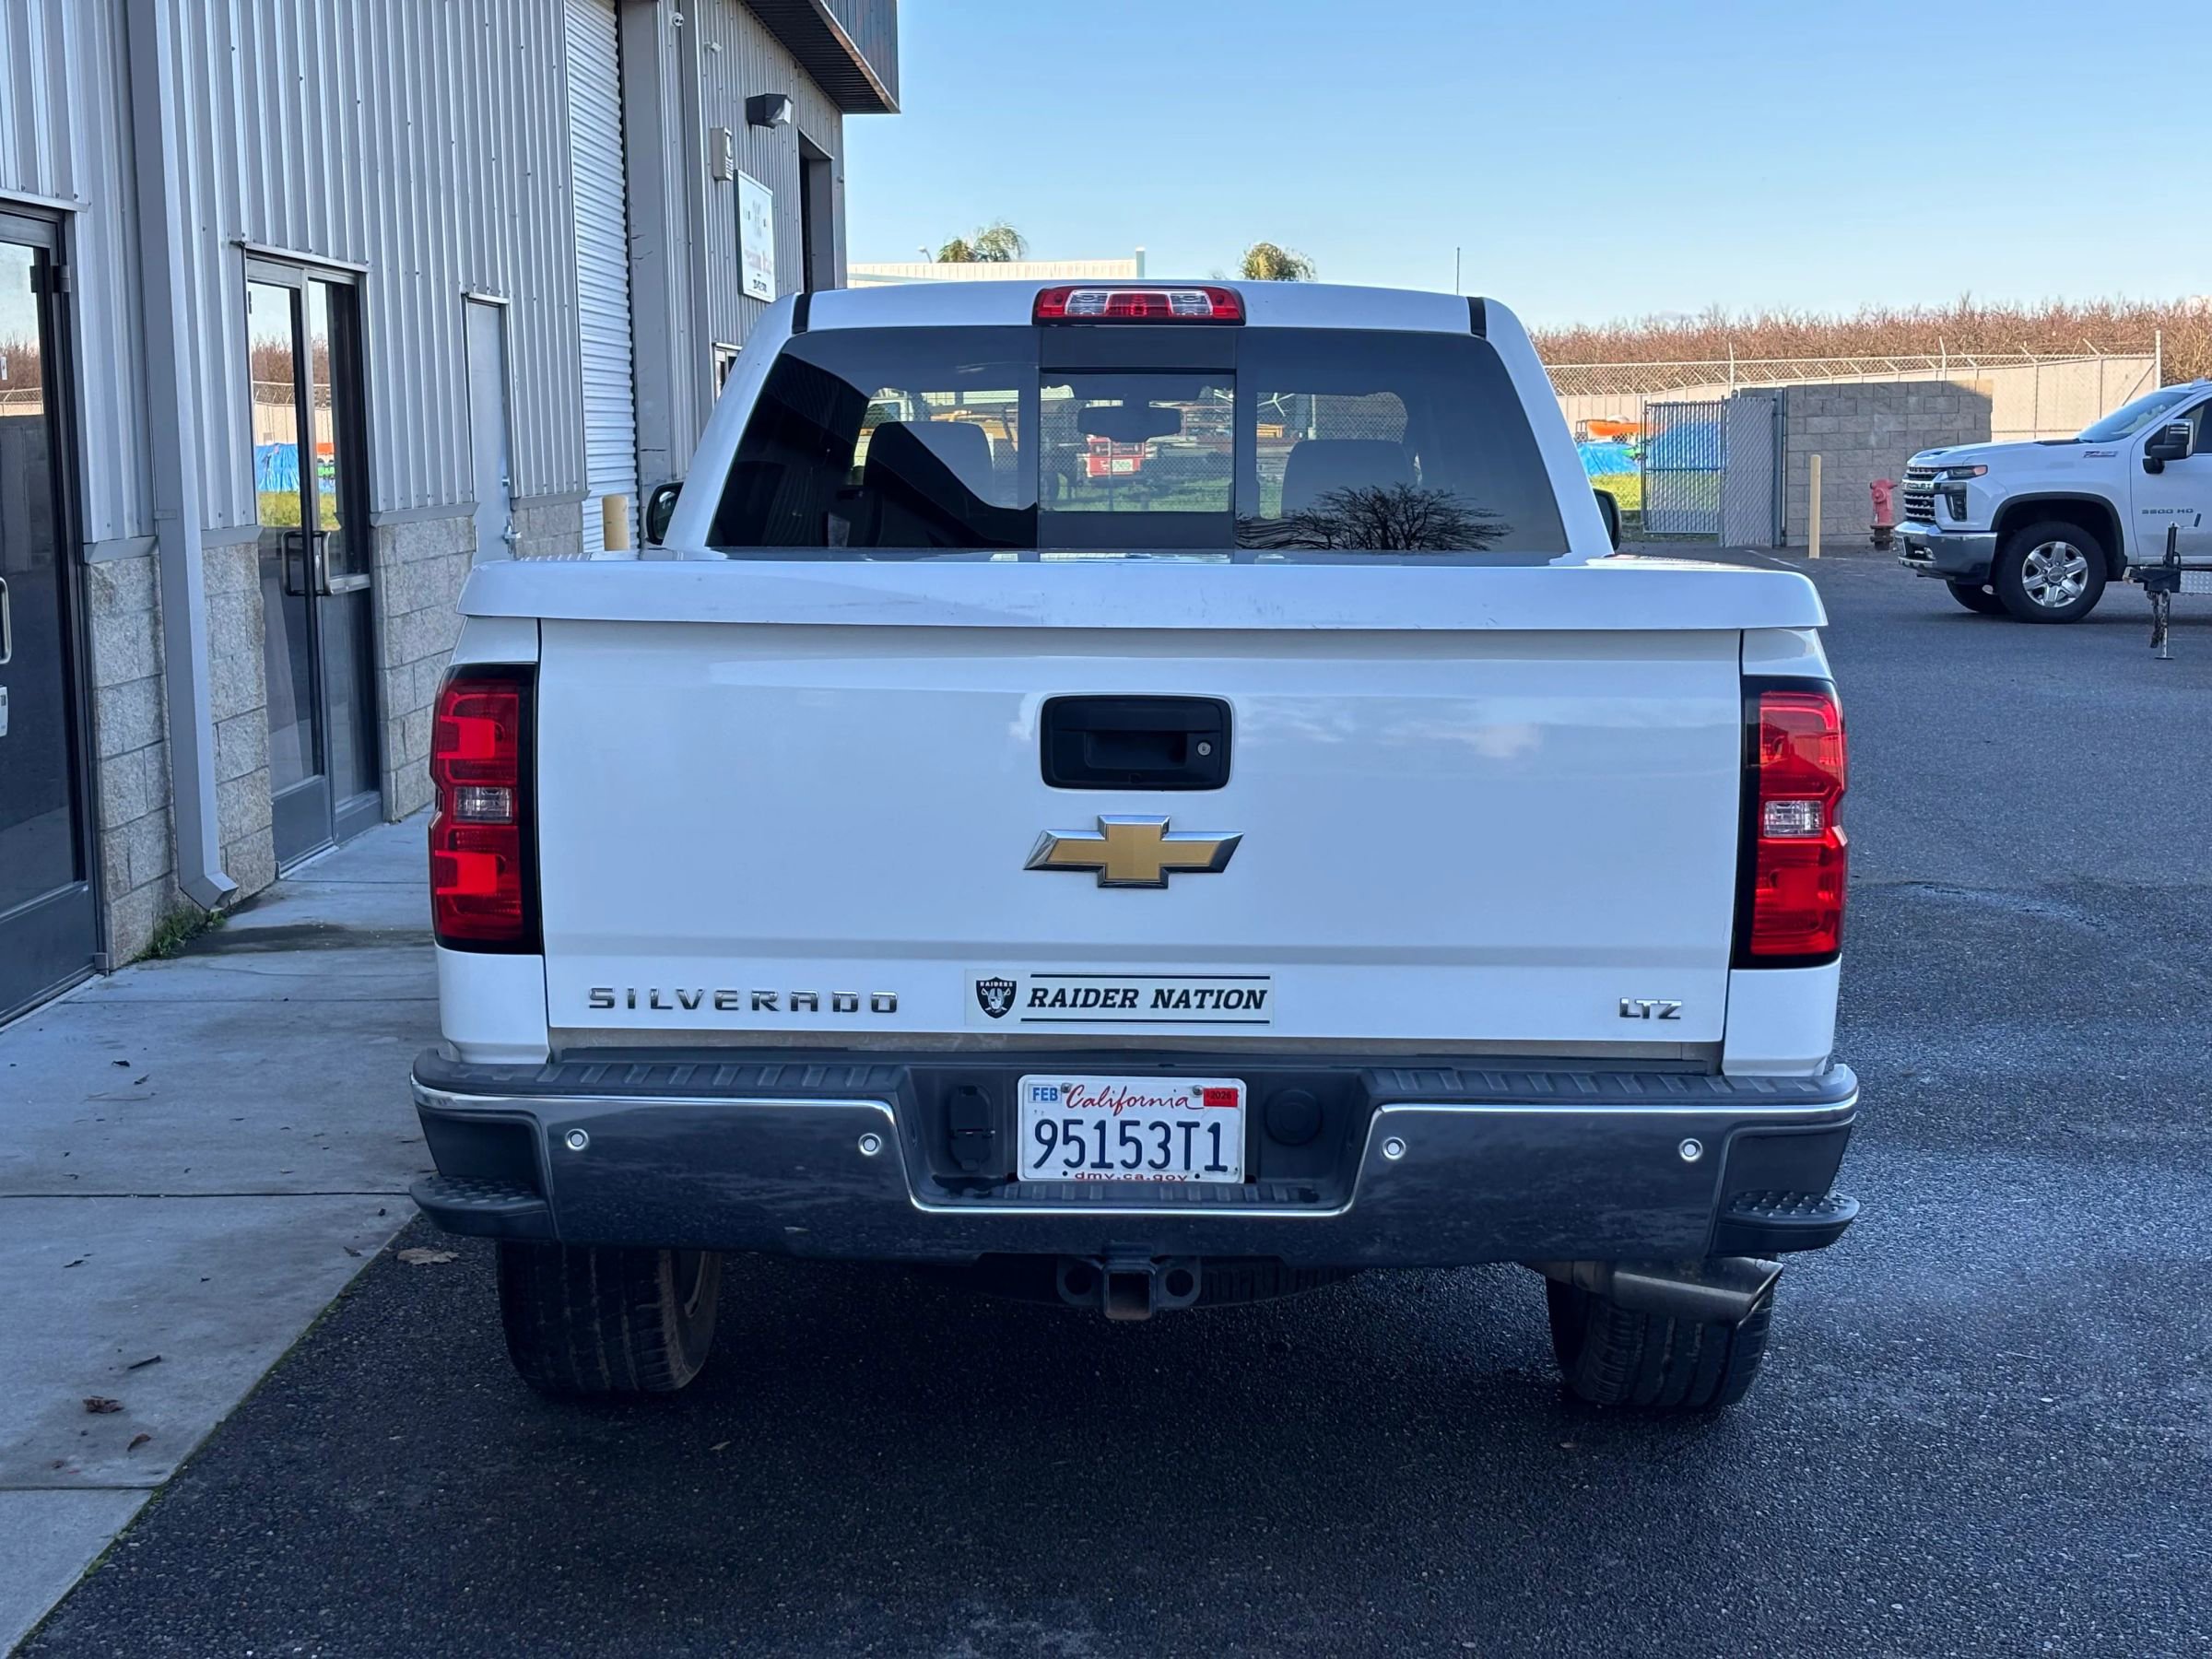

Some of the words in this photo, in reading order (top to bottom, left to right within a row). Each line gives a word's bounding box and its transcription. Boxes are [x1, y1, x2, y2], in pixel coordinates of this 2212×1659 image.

[588, 987, 899, 1014] SILVERADO
[1027, 987, 1139, 1009] RAIDER
[1150, 988, 1268, 1010] NATION
[1619, 997, 1682, 1019] LTZ
[1032, 1087, 1059, 1101] FEB
[1065, 1084, 1205, 1117] California
[1032, 1118, 1229, 1172] 95153T1
[1075, 1171, 1188, 1182] dmv.ca.gov
